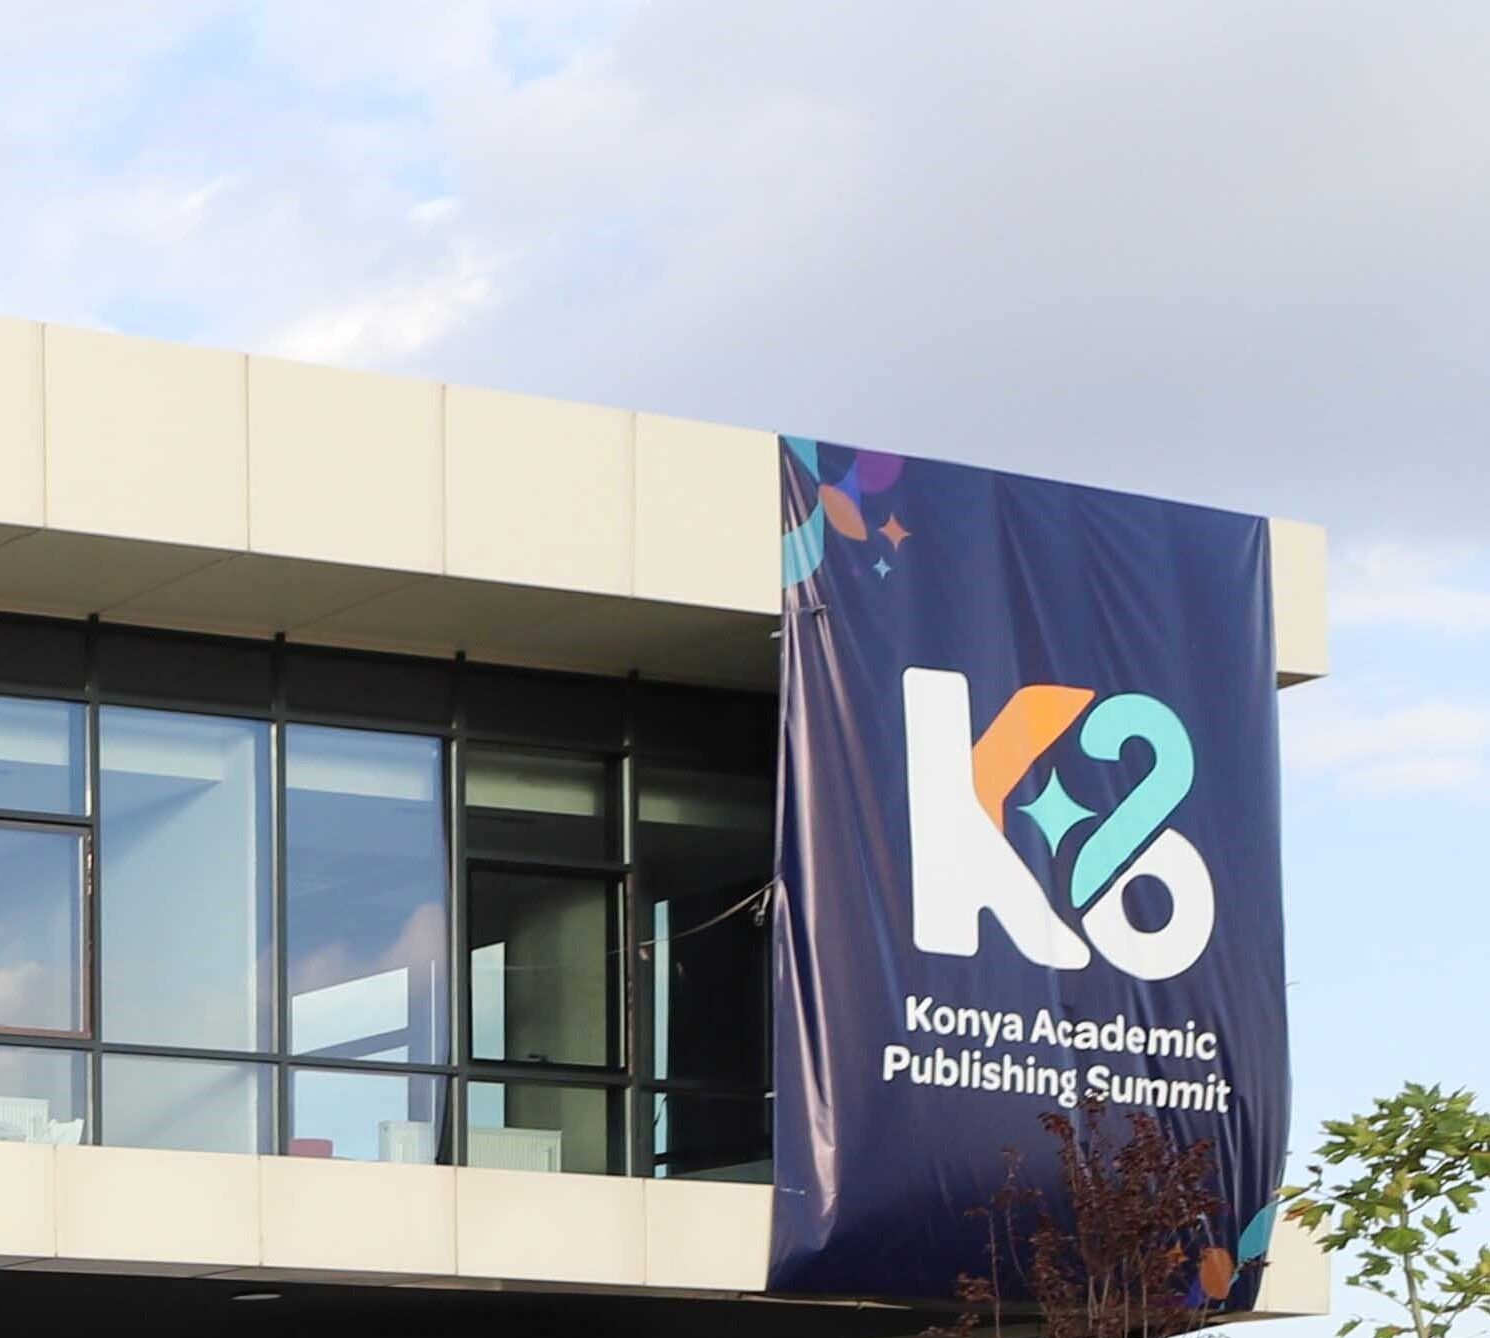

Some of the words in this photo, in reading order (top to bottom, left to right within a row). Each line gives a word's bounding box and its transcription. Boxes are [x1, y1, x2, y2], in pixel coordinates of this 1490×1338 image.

[905, 995, 1024, 1048] Konya
[1030, 1008, 1218, 1061] Academic
[882, 1044, 1079, 1109] Publishing
[1085, 1064, 1232, 1113] Summit
